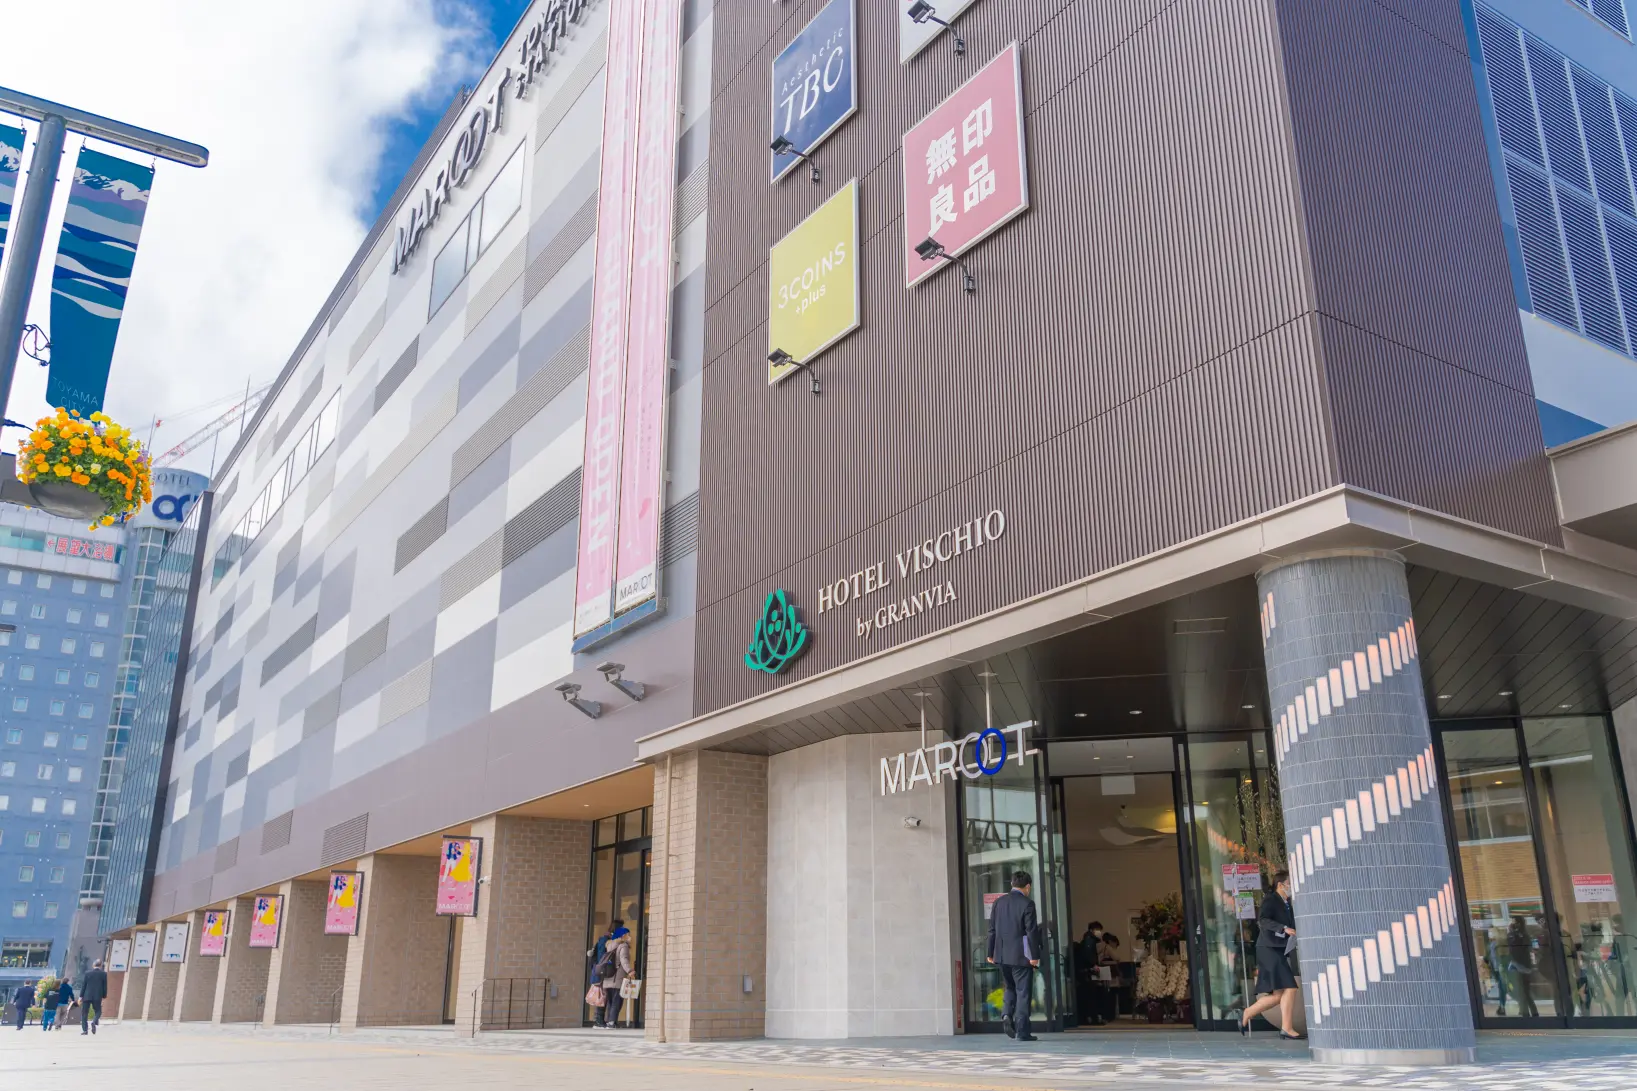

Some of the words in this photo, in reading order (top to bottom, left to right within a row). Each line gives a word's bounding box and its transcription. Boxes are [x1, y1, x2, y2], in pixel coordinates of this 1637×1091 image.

[780, 45, 844, 135] TBC
[781, 26, 844, 95] Aesthetic
[926, 97, 993, 184] 無印
[929, 154, 995, 237] 良品
[778, 242, 845, 309] 3COINS
[51, 376, 98, 406] TOYAMA
[61, 397, 85, 414] CITY
[152, 472, 191, 488] OTEL
[587, 412, 616, 554] OPEN
[818, 561, 892, 614] HOTEL
[896, 509, 1005, 579] VISCHIO
[856, 617, 873, 640] by
[875, 581, 957, 630] GRANVIA
[880, 719, 1033, 796] MAROOT
